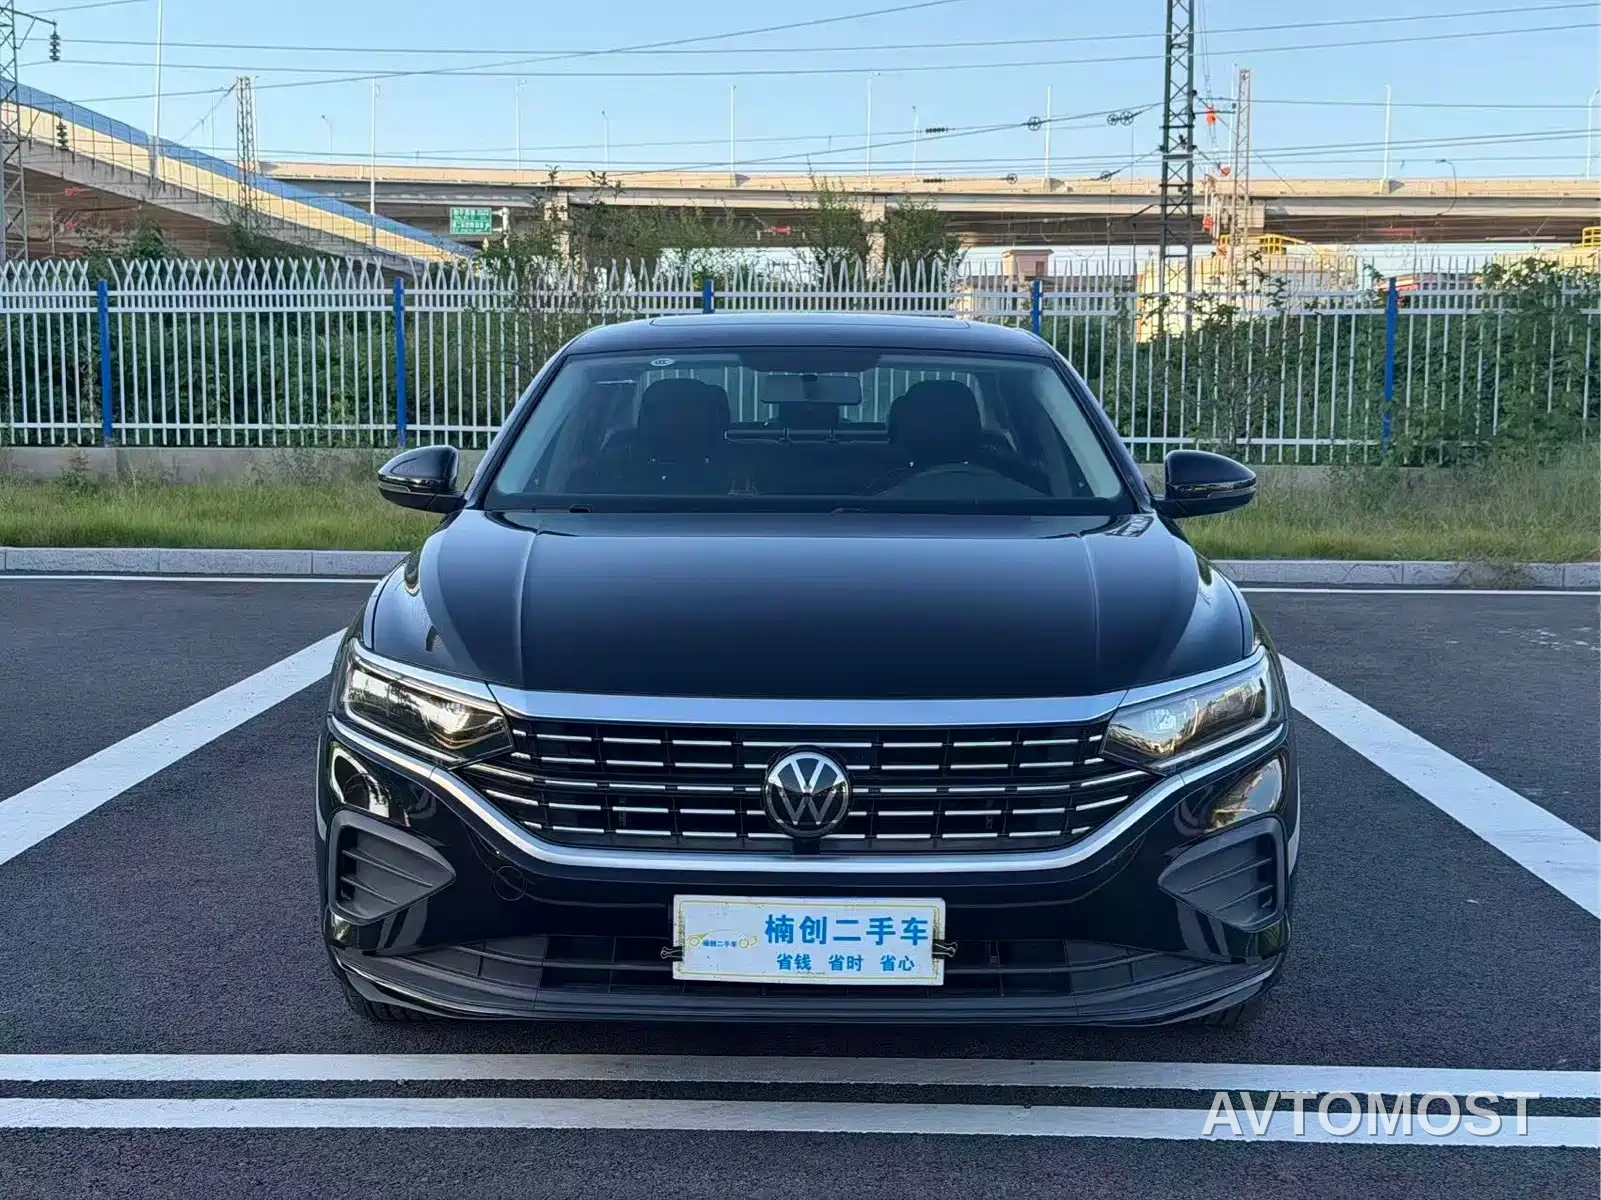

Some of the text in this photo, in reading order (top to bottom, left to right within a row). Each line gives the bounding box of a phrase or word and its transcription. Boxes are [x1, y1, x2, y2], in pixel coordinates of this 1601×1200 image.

[765, 914, 929, 946] 楠创二手车
[776, 953, 915, 972] 省钱 省时 省心
